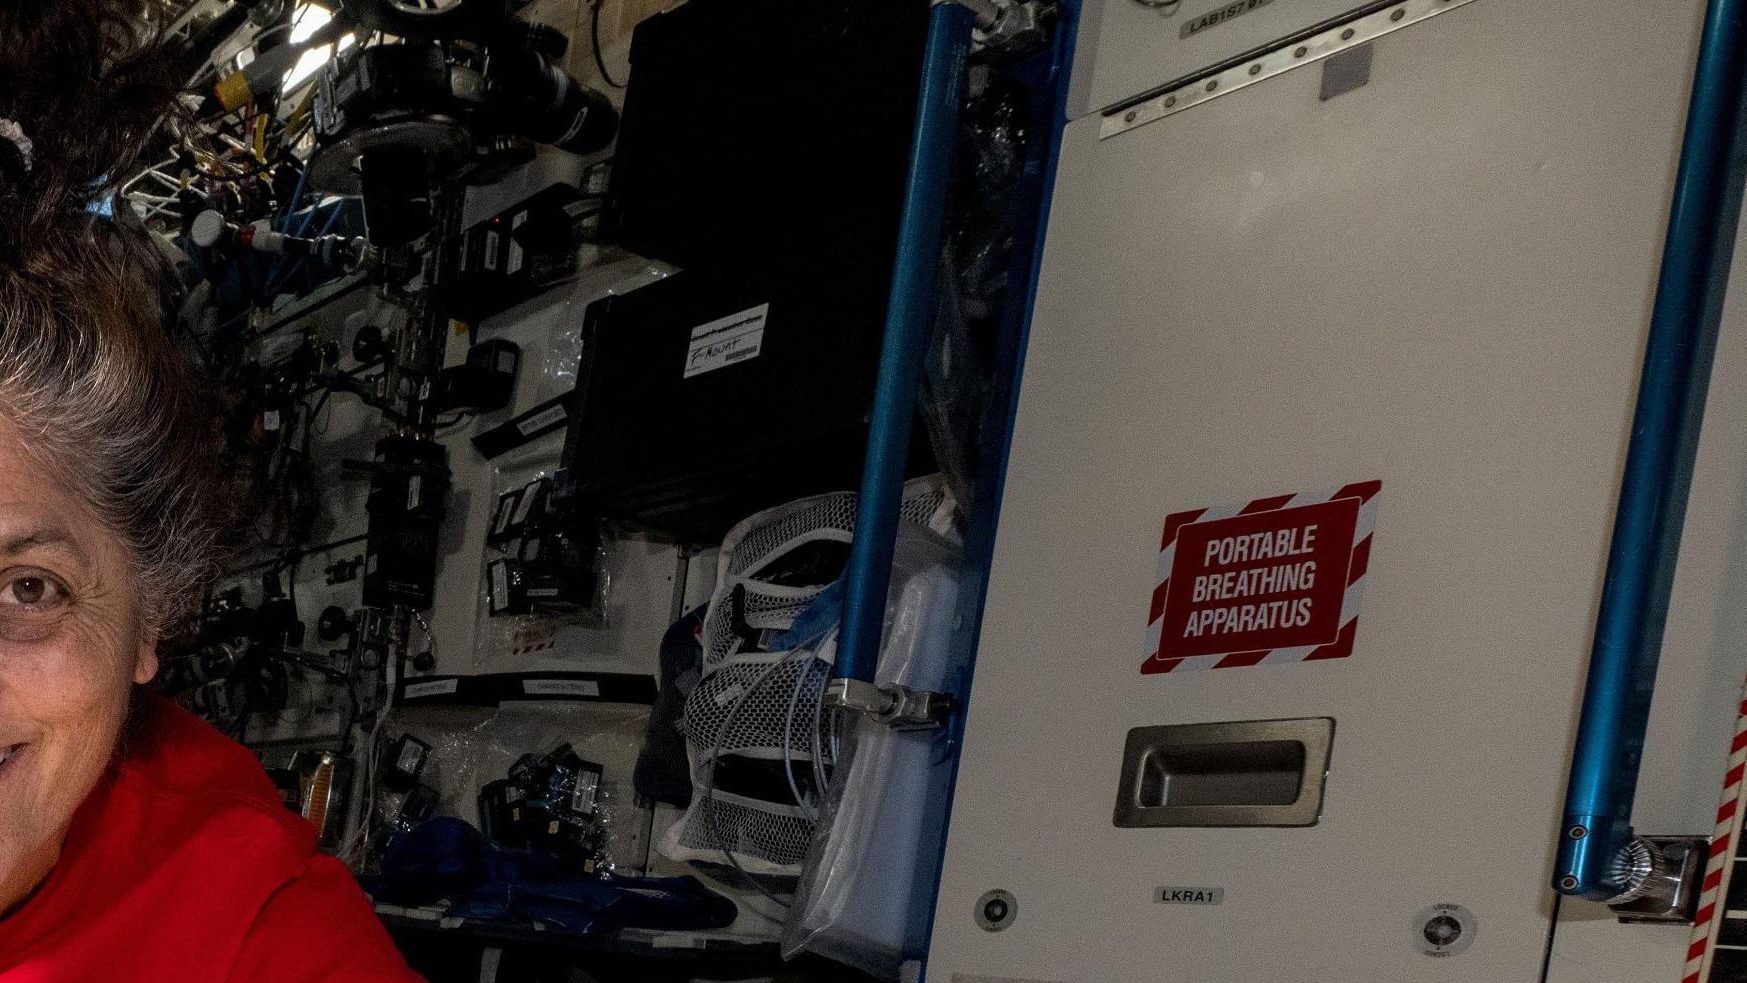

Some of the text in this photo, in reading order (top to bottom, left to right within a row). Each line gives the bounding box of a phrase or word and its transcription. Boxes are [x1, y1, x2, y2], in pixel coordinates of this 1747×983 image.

[1203, 523, 1317, 568] PORTABLE
[1192, 560, 1317, 604] BREATHING
[1183, 597, 1312, 639] APPARATUS
[1160, 888, 1216, 903] LKRA1
